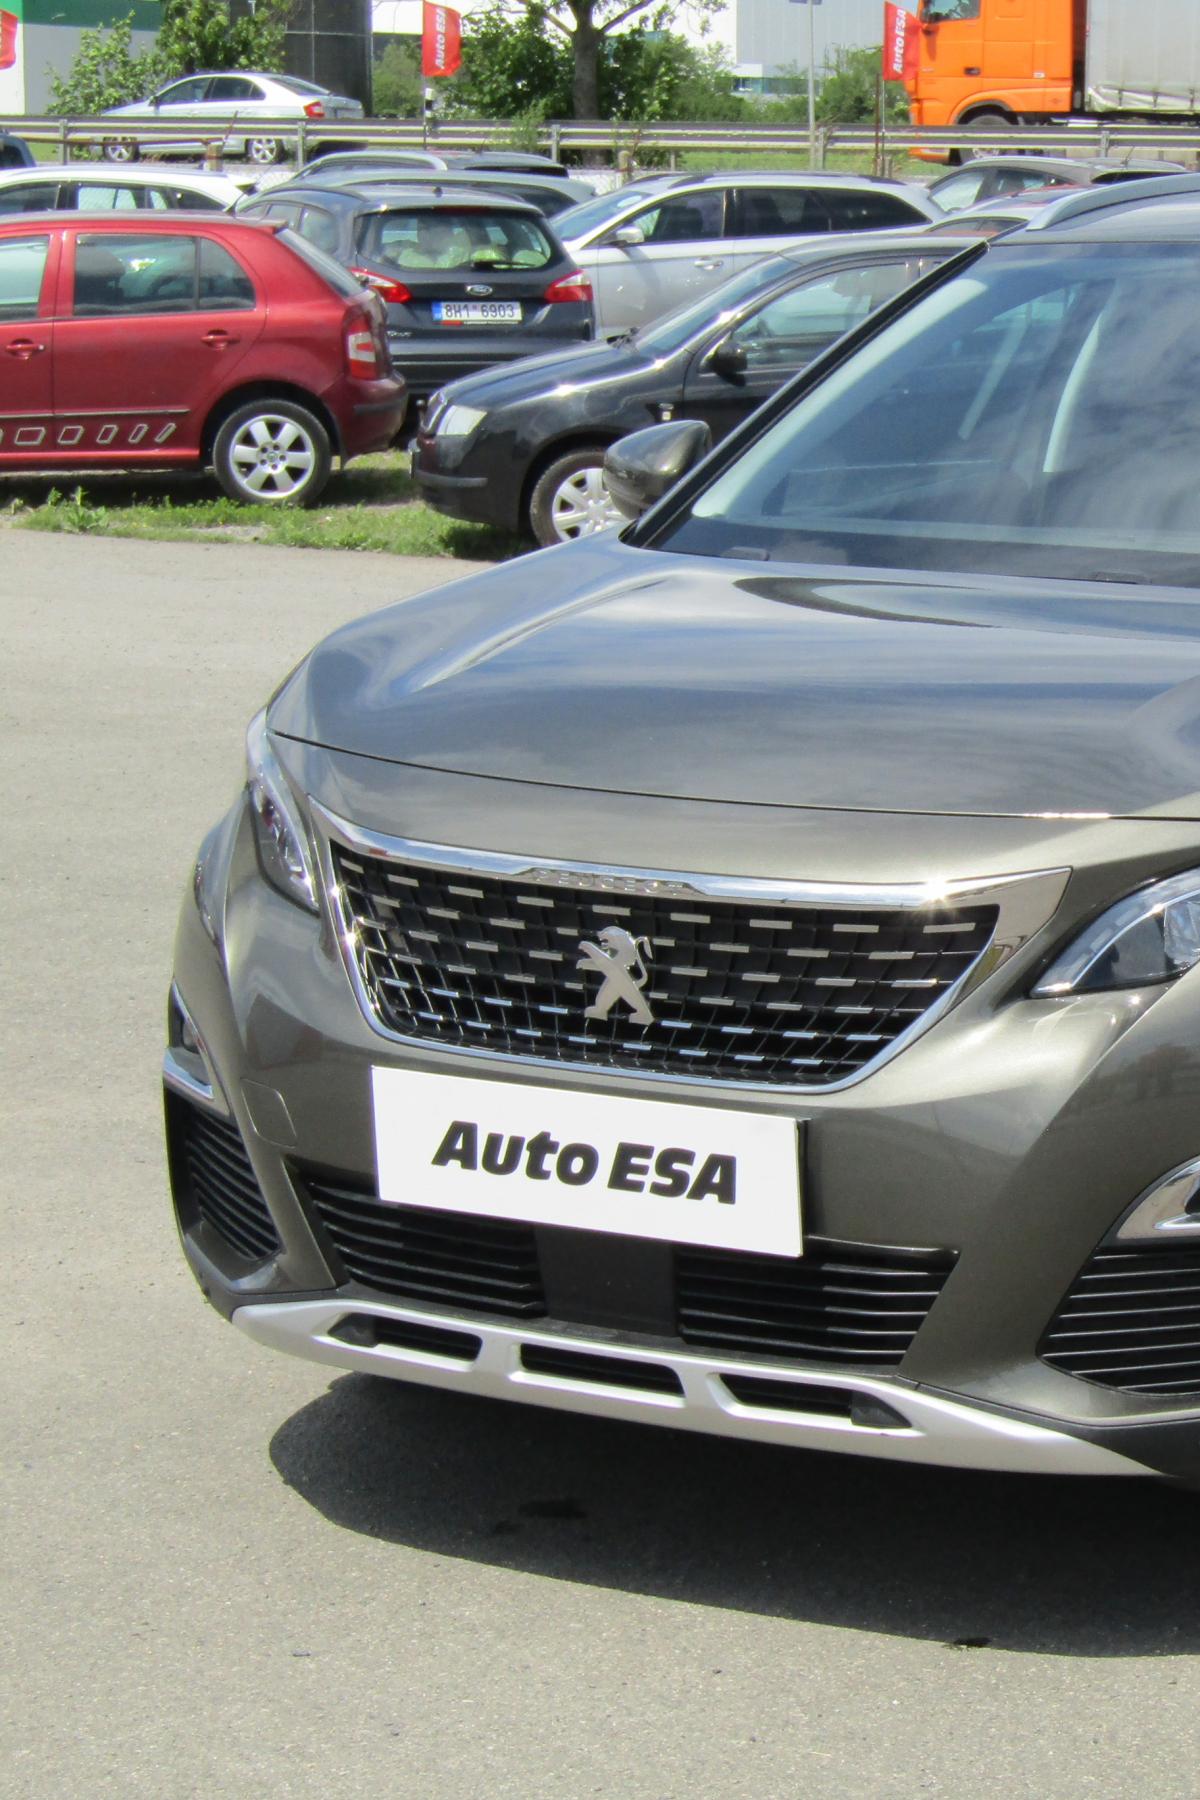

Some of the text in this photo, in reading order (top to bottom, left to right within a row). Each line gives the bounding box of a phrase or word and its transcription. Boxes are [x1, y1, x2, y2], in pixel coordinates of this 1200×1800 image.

[434, 33, 446, 70] Auto
[893, 7, 906, 75] Auto ESA
[445, 303, 515, 318] 8H1 6903
[534, 868, 684, 896] PEUGEOT
[431, 1120, 738, 1205] Auto ESA
